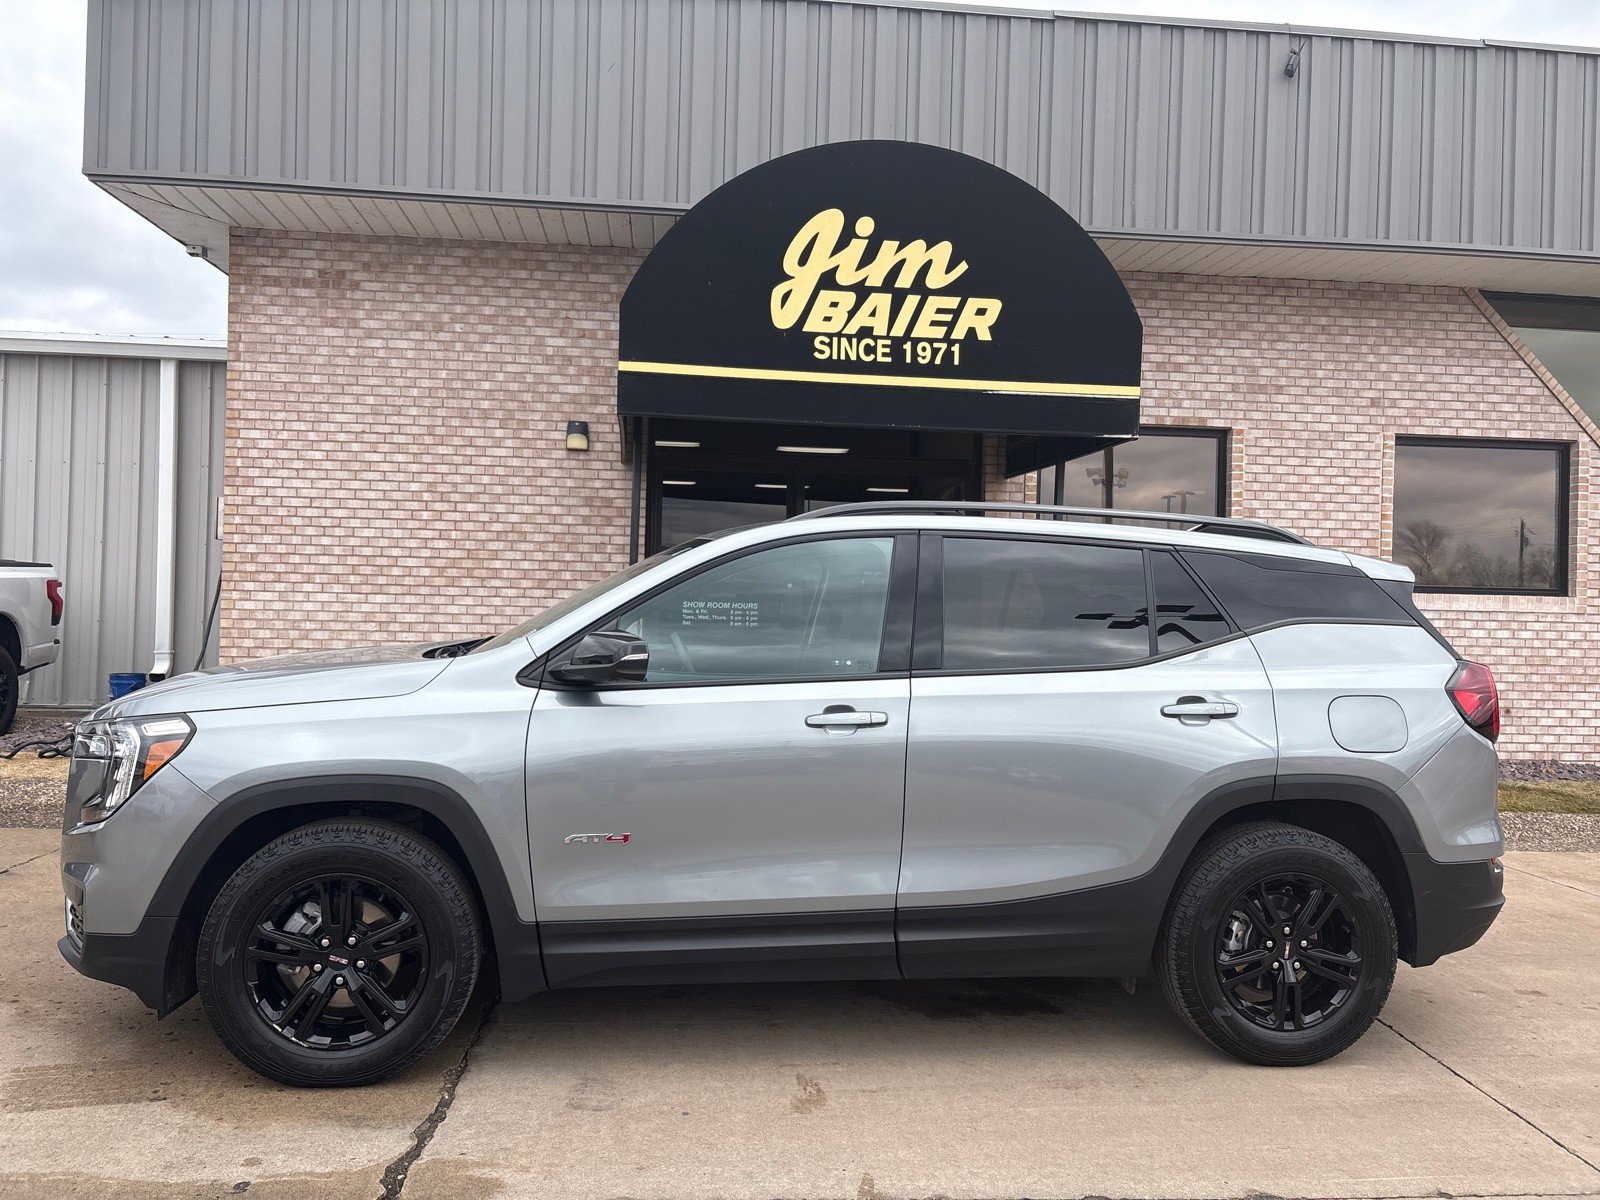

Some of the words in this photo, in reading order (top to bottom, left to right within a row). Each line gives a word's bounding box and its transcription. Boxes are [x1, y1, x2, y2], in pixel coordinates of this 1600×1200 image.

[770, 208, 969, 330] Jim
[801, 289, 1003, 341] BAIER
[813, 335, 892, 363] SINCE
[902, 341, 961, 366] 1971
[564, 832, 631, 845] AT4
